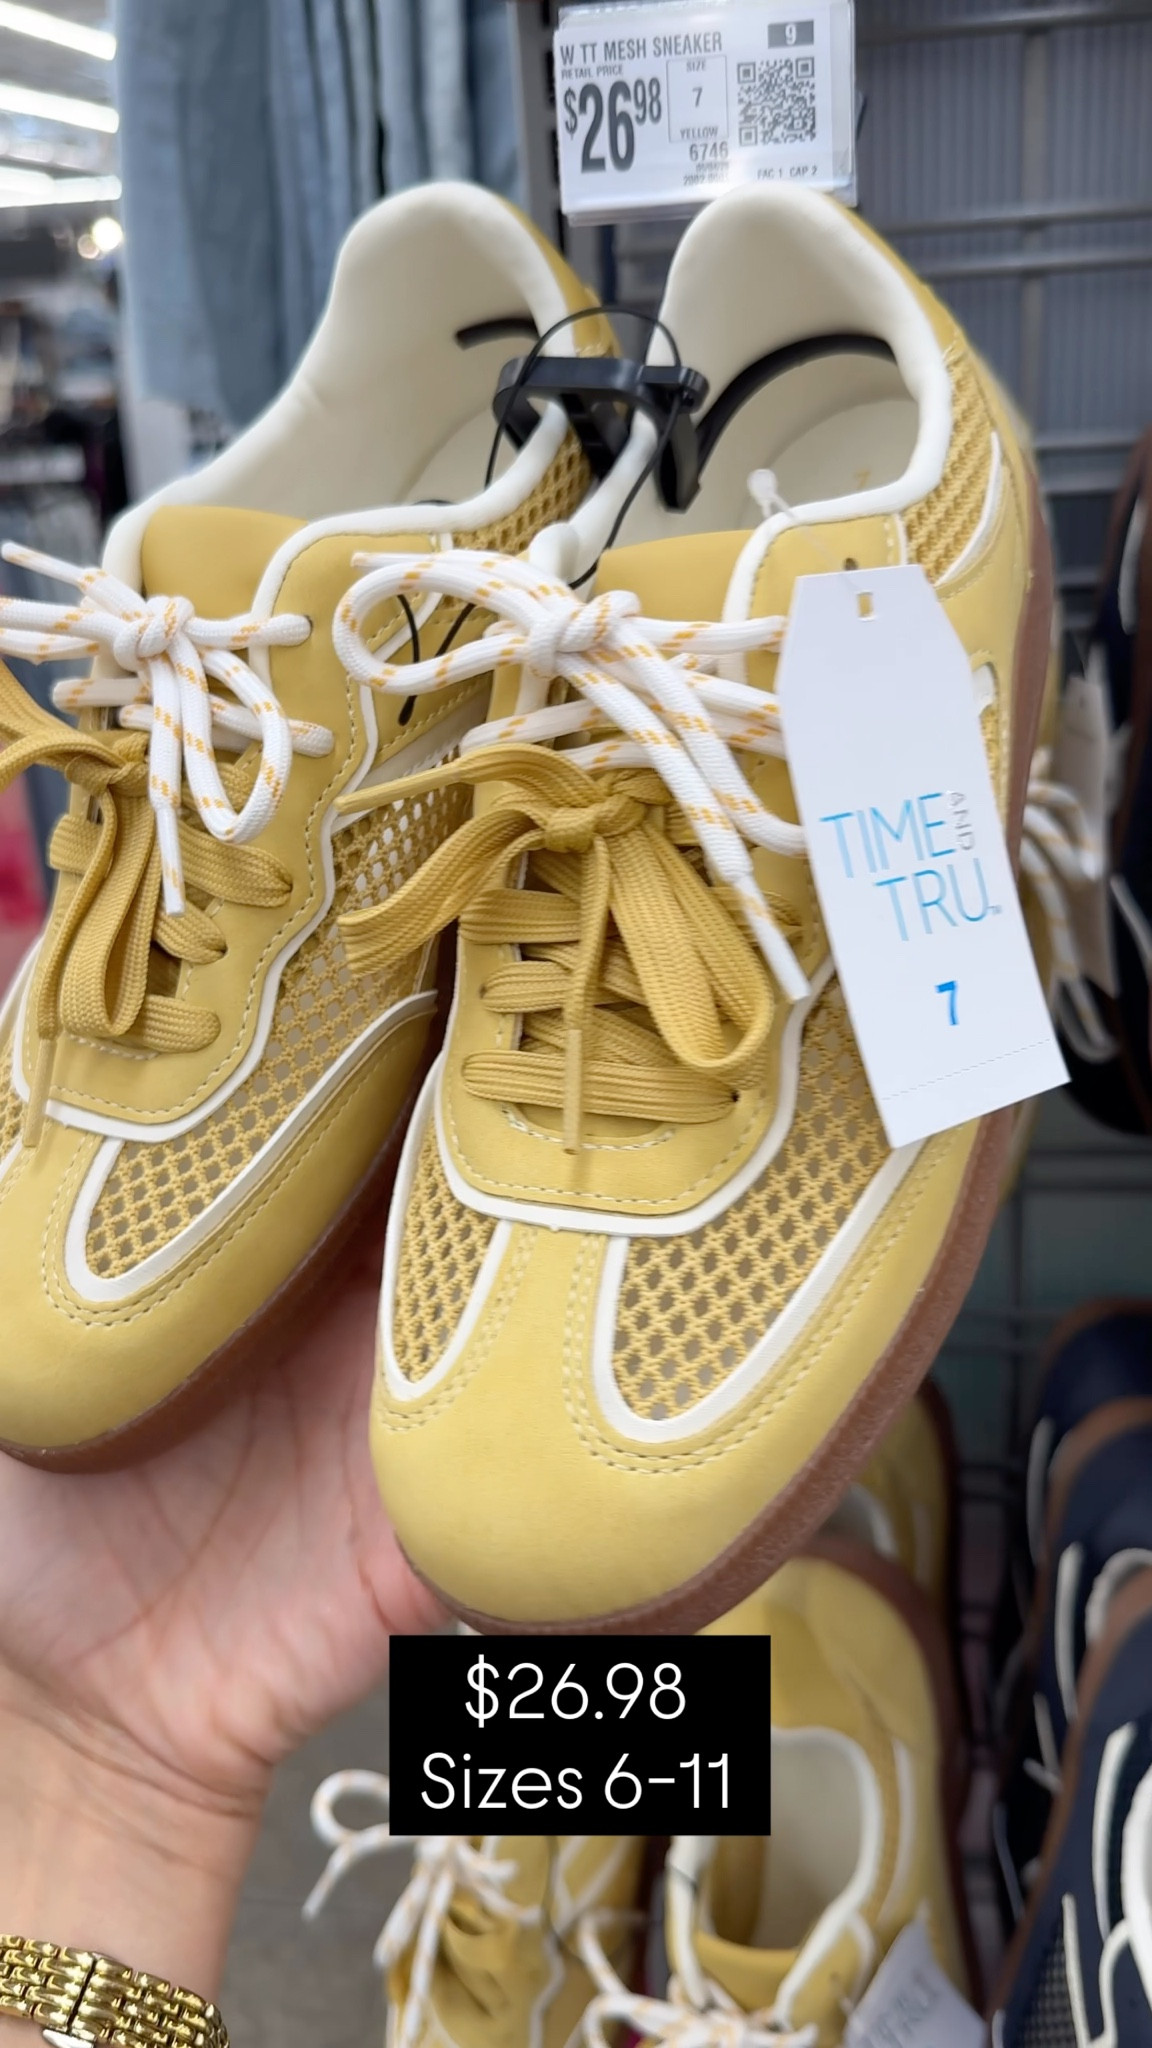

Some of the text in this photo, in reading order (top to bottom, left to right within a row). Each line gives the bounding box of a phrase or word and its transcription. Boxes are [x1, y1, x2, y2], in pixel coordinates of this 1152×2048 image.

[784, 25, 798, 45] 9
[560, 31, 723, 66] W TT MESH SNEAKER
[561, 64, 624, 80] RETAIL PRICE
[686, 60, 707, 73] SIZE
[692, 87, 704, 108] 7
[679, 126, 719, 140] YELLOW
[689, 140, 729, 162] 6746
[789, 165, 809, 178] CAP
[948, 791, 976, 850] AND
[819, 792, 957, 879] TIME
[935, 980, 959, 1026] 7
